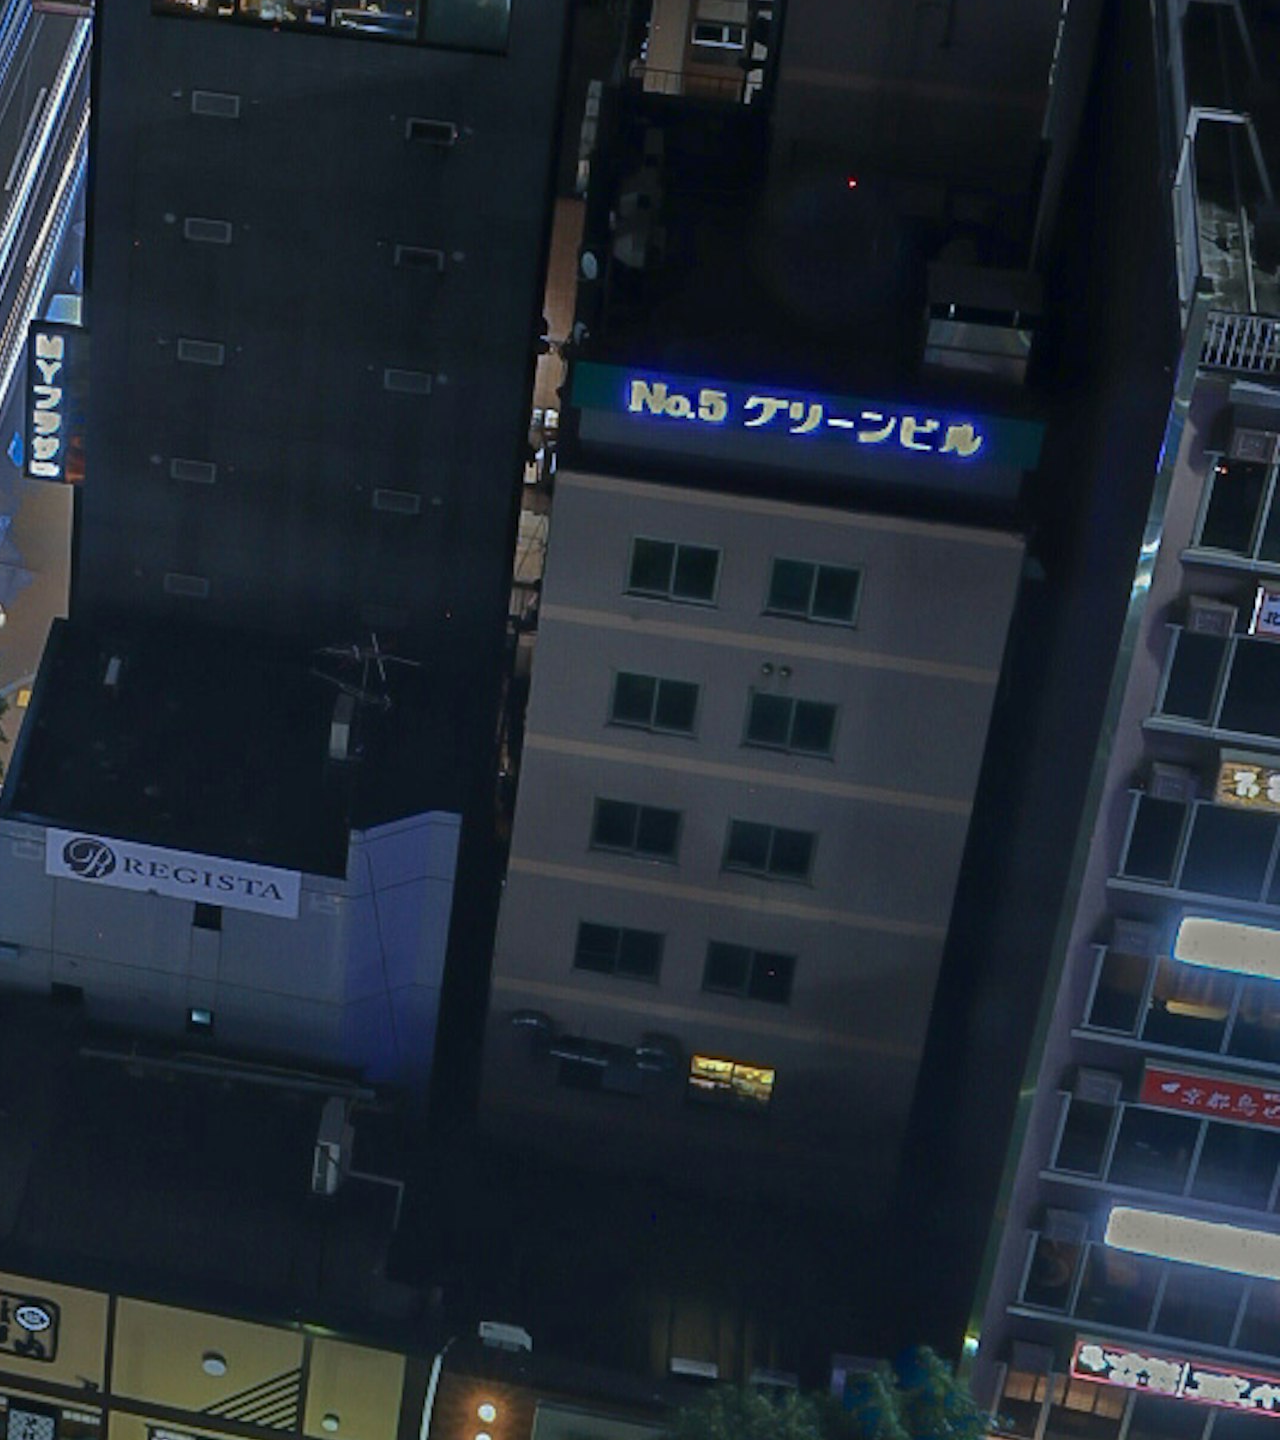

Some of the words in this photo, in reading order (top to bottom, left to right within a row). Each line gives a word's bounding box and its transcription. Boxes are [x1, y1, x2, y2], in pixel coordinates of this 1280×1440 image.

[627, 379, 728, 422] No.5
[743, 394, 985, 458] グリーンビル
[122, 855, 284, 901] REGISTA
